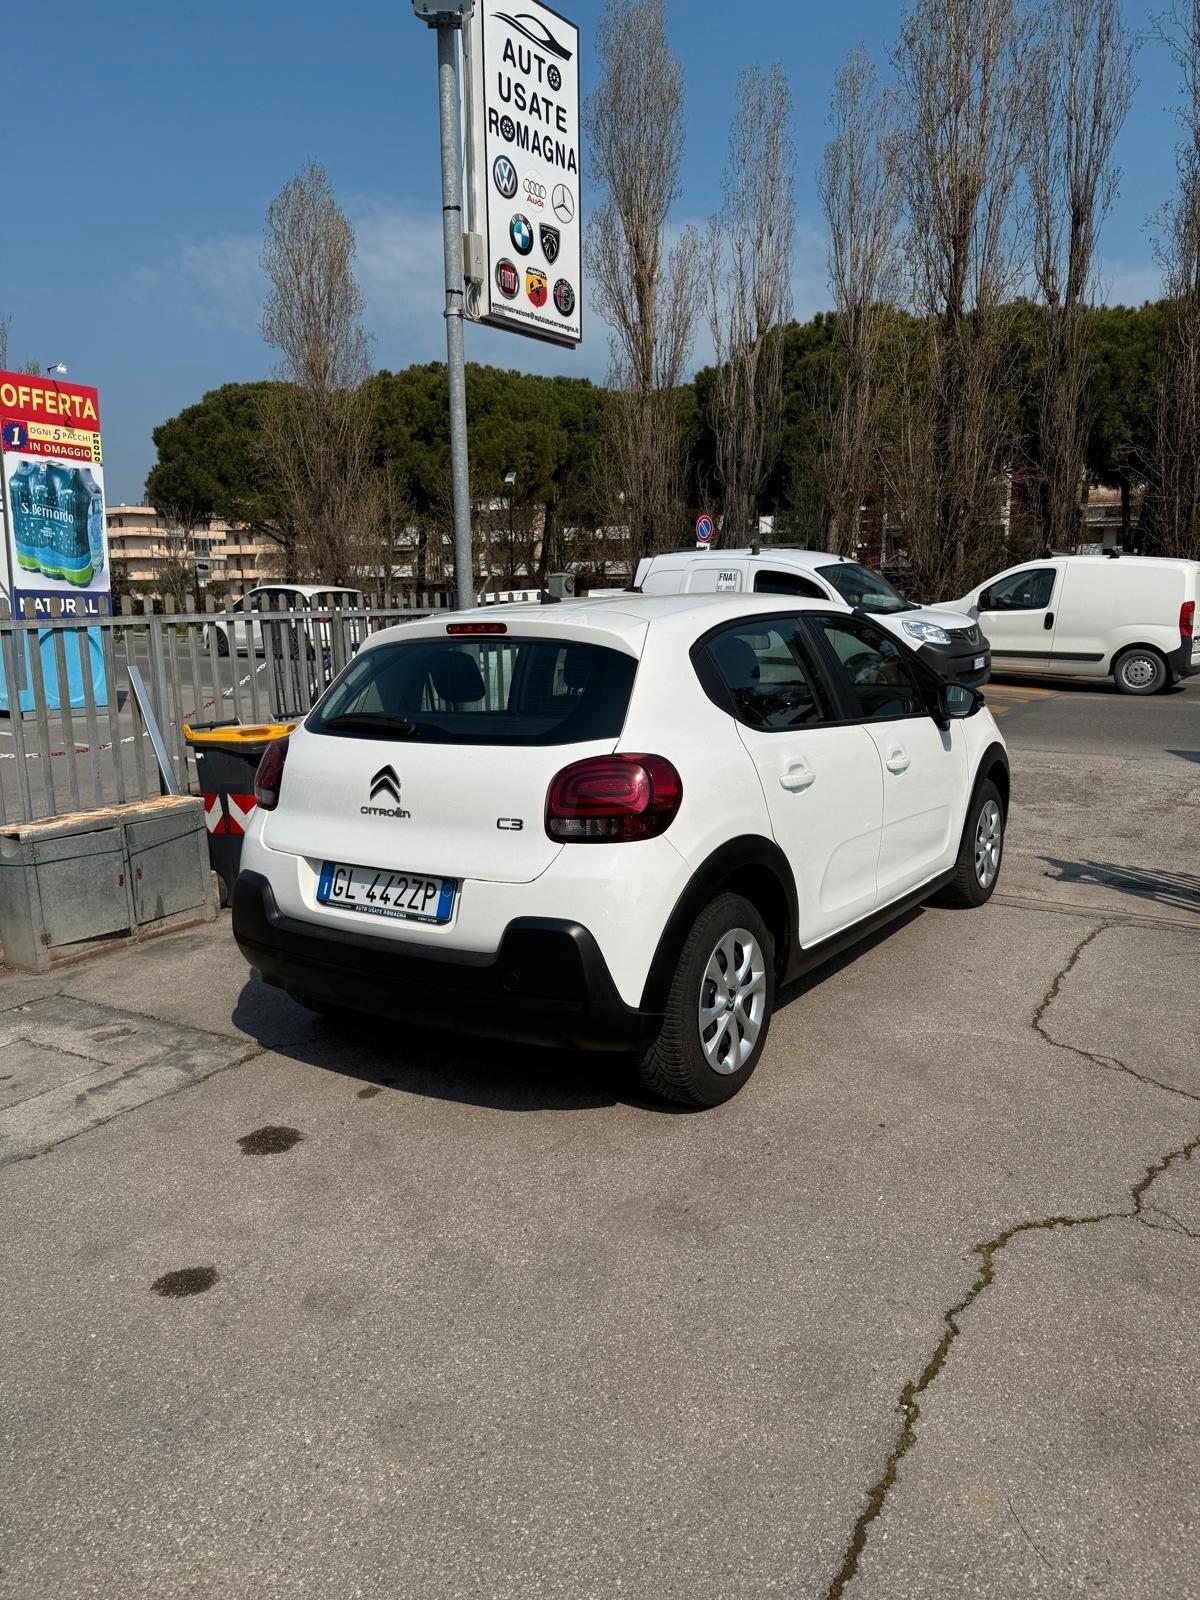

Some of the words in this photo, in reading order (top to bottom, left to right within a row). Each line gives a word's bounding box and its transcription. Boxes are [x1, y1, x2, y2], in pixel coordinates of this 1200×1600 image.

[503, 37, 561, 92] AUTO
[498, 72, 568, 134] USATE
[488, 107, 578, 175] ROMAGNA
[526, 194, 544, 208] Audi
[501, 269, 516, 290] FIAT
[0, 383, 98, 421] OFFERTA
[11, 426, 21, 446] 1
[29, 426, 52, 436] OGNI
[52, 428, 61, 441] 5
[62, 432, 91, 443] PACCHI
[29, 441, 41, 452] IN
[43, 444, 92, 458] OMAGGIO
[92, 433, 101, 462] PROMO
[496, 817, 524, 831] C3
[332, 868, 356, 900] GL
[365, 873, 437, 911] 442ZP
